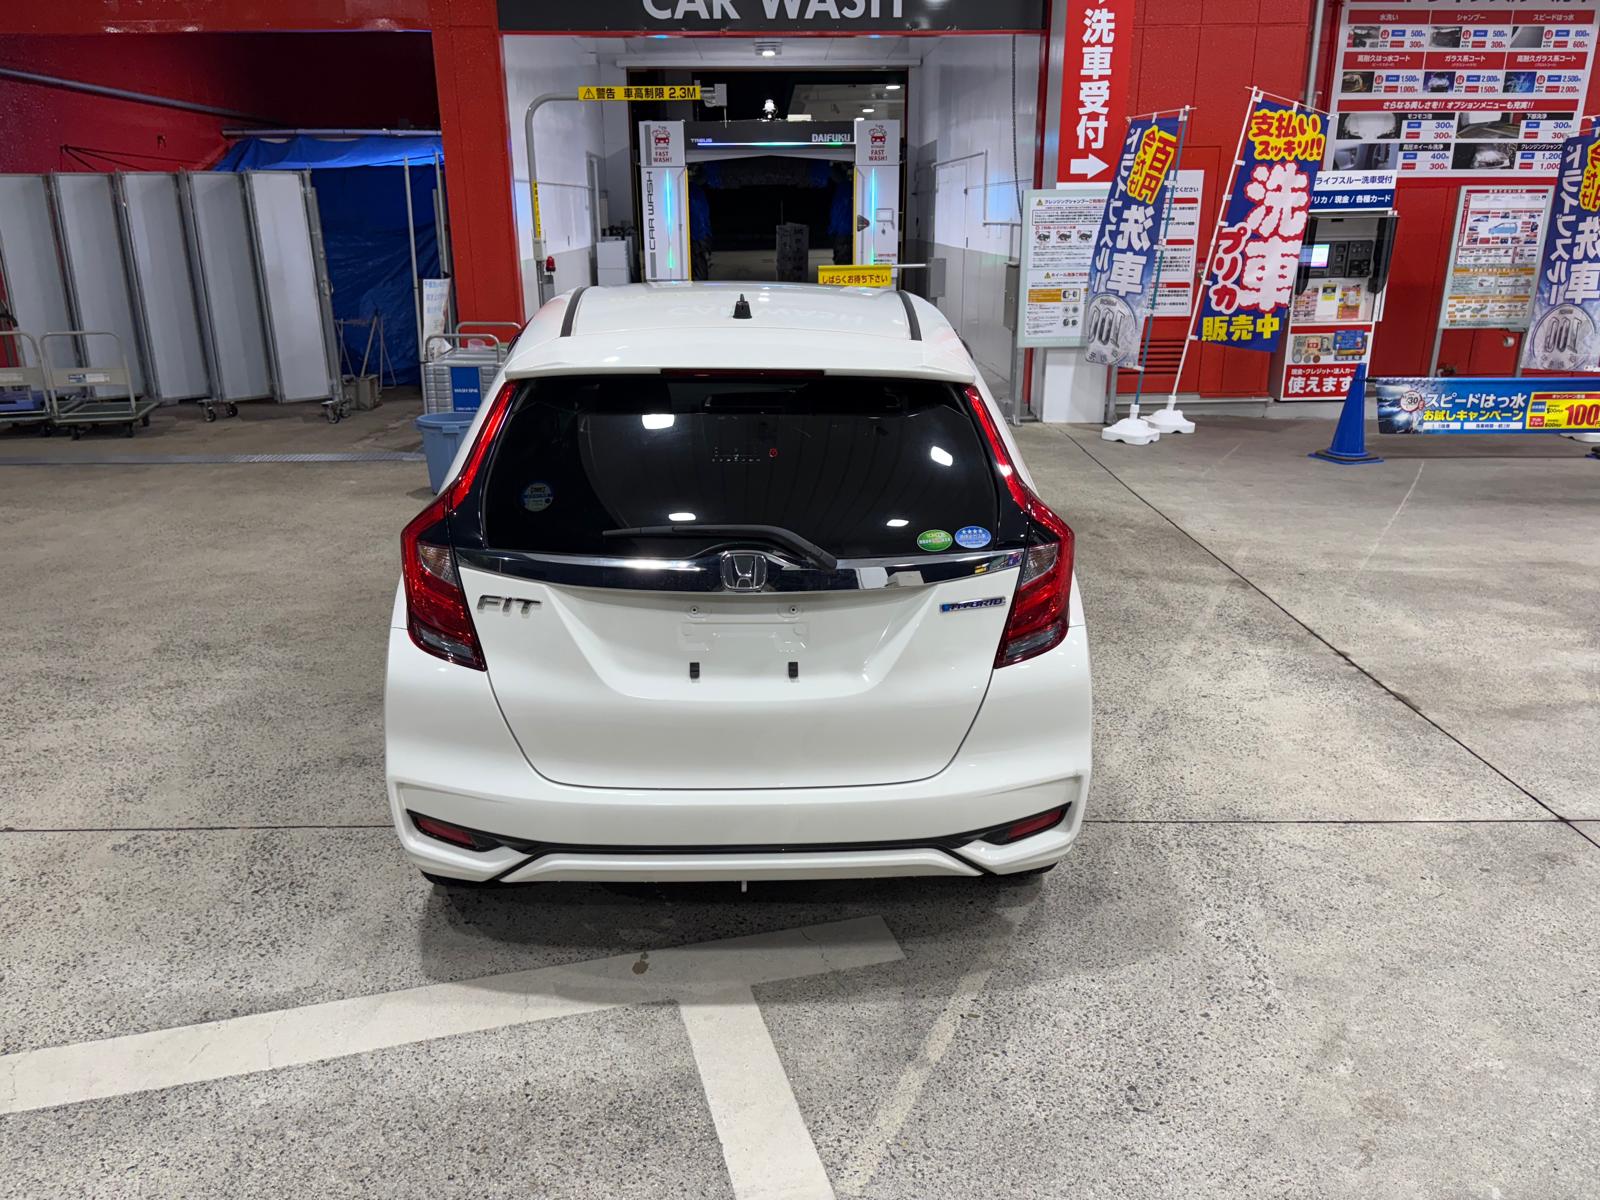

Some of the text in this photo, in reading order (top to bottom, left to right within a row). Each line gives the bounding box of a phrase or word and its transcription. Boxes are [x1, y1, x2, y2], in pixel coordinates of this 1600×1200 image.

[1445, 54, 1486, 62] ガラス系コート
[1076, 8, 1116, 149] 洗車受付
[595, 87, 697, 99] 警告 車高制限 2.3M
[1251, 112, 1320, 138] 支払い
[812, 133, 850, 142] DAIFUKU
[1256, 136, 1324, 157] スッキリ!!
[1356, 194, 1391, 203] 各種カード
[646, 171, 656, 251] CAR WASH
[1238, 160, 1308, 312] 洗車
[822, 275, 888, 285] しばらくお待ち下さい
[1213, 227, 1248, 312] プリカ
[1202, 313, 1280, 341] 販売中
[1425, 392, 1526, 408] スピードはっ水
[1423, 410, 1524, 421] お試しキャンペーン
[477, 594, 542, 617] FIT
